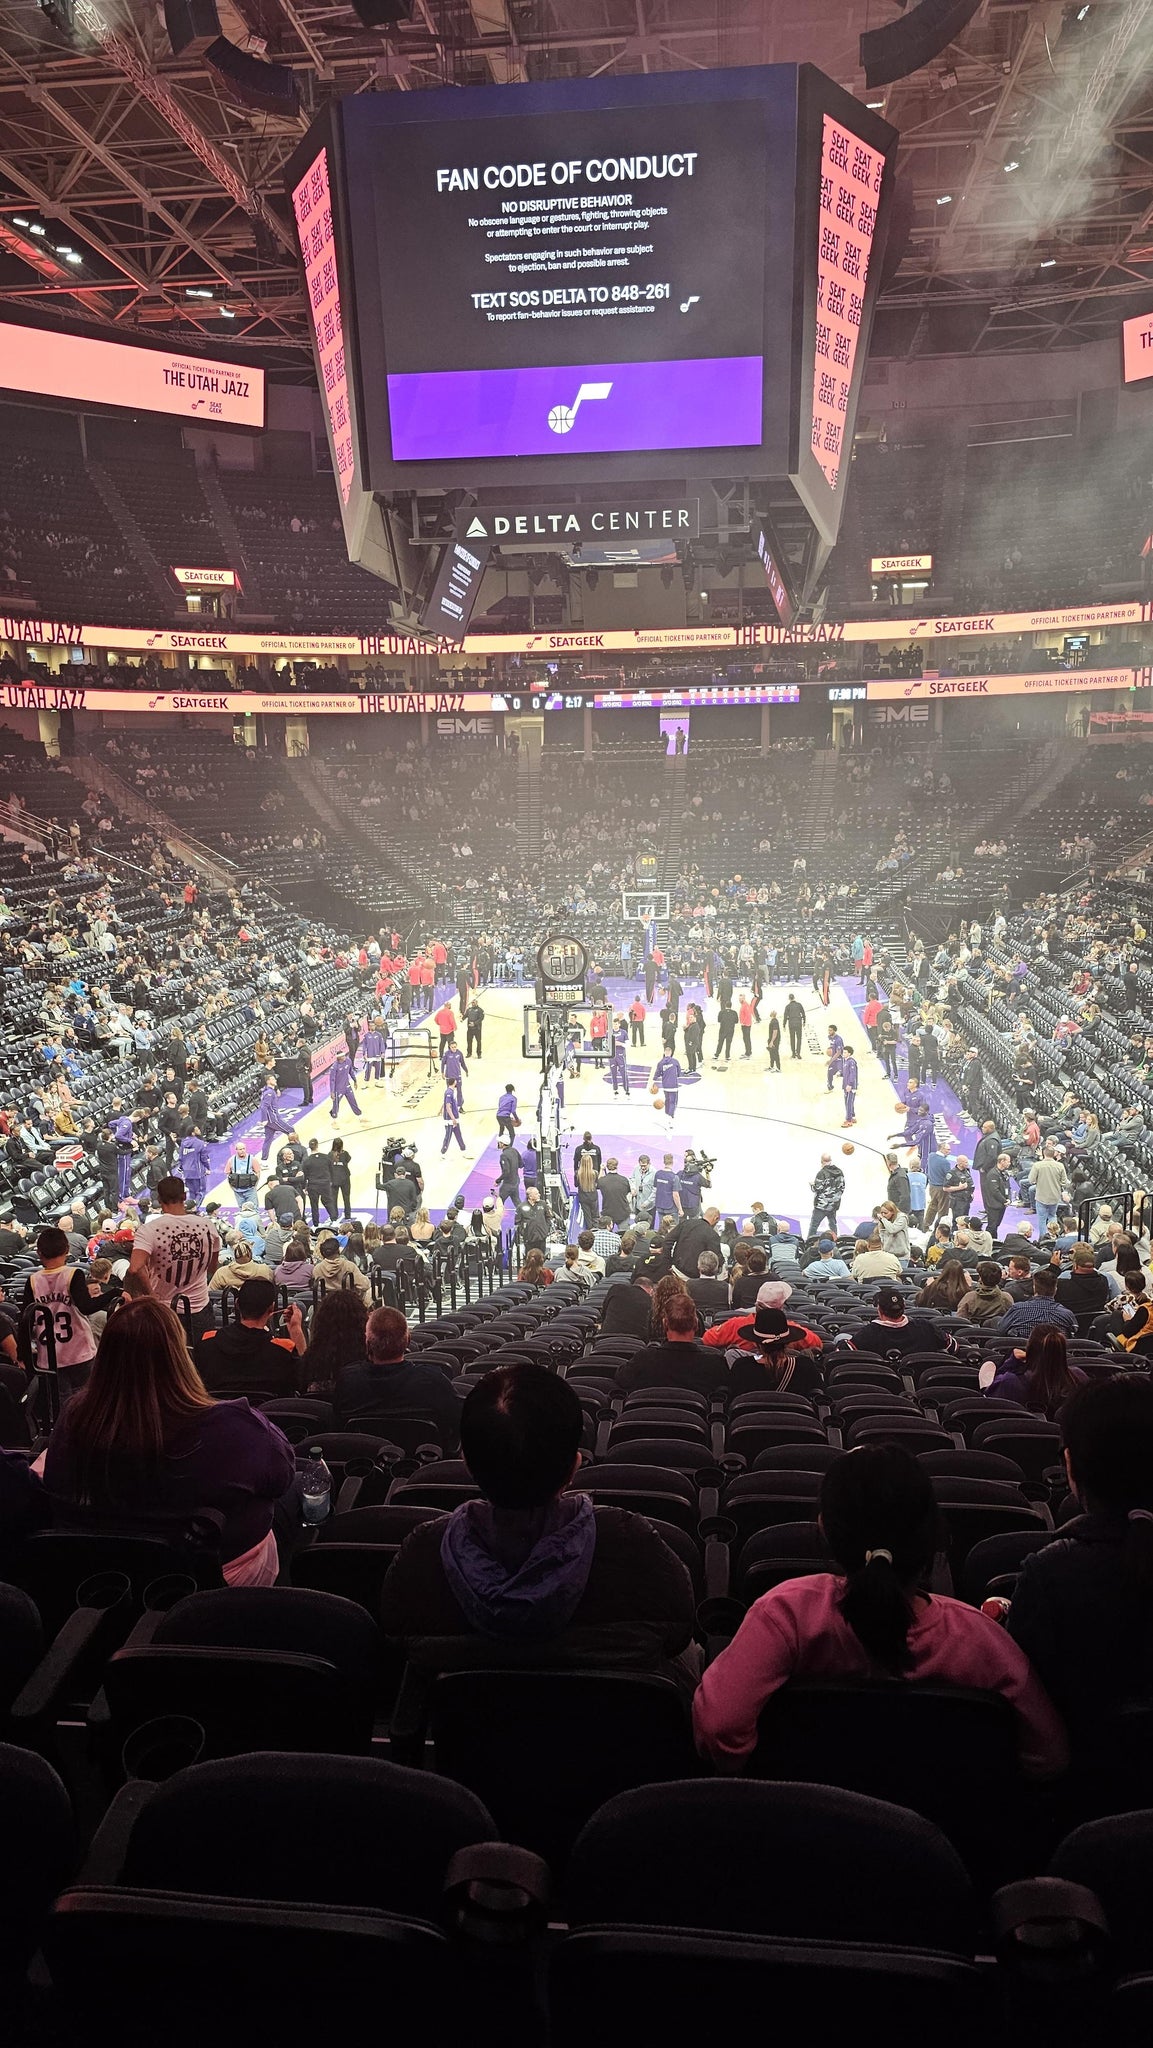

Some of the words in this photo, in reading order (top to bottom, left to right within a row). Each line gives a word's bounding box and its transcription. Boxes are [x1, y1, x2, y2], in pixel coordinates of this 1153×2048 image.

[832, 130, 849, 154] SEAT
[829, 148, 848, 173] GEEK
[855, 147, 872, 169] SEAT
[437, 167, 478, 192] FAN
[483, 162, 547, 189] CODE
[551, 161, 582, 185] OF
[586, 153, 698, 182] CONDUCT
[852, 164, 870, 188] GEEK
[501, 202, 518, 213] NO
[520, 198, 578, 212] DISRUPTIVE
[581, 194, 633, 208] BEHAVIOR
[838, 186, 856, 209] SEAT
[468, 218, 478, 227] No
[480, 217, 508, 225] obscene
[509, 216, 540, 225] language
[550, 213, 581, 224] gestures,
[581, 210, 610, 221] fighting,
[610, 209, 641, 218] throwing
[642, 207, 668, 218] objects
[836, 204, 854, 228] GEEK
[495, 227, 533, 238] attempting
[542, 226, 560, 234] enter
[561, 225, 573, 233] the
[574, 224, 593, 232] court
[602, 221, 632, 231] interrupt
[634, 220, 649, 231] play.
[823, 227, 840, 249] SEAT
[485, 253, 523, 263] Spectators
[524, 251, 556, 261] engaging
[557, 250, 563, 258] in
[564, 249, 581, 258] such
[582, 247, 613, 257] behavior
[627, 245, 653, 255] subject
[821, 244, 839, 268] GEEK
[845, 241, 861, 262] SEAT
[508, 264, 516, 272] to
[517, 263, 547, 273] ejection,
[548, 262, 561, 270] ban
[563, 260, 576, 269] and
[577, 259, 606, 270] possible
[607, 257, 630, 266] arrest.
[842, 258, 860, 280] GEEK
[471, 292, 508, 309] TEXT
[510, 290, 539, 307] SOS
[543, 288, 587, 305] DELTA
[588, 287, 608, 303] TO
[829, 281, 846, 302] SEAT
[486, 313, 495, 321] To
[496, 313, 516, 322] report
[517, 310, 560, 320] fan-behavior
[562, 309, 583, 317] issues
[591, 306, 618, 316] request
[618, 305, 655, 314] assistance
[827, 298, 845, 319] GEEK
[835, 333, 851, 352] SEAT
[833, 349, 850, 369] GEEK
[172, 362, 192, 371] OFFICIAL
[193, 366, 215, 374] TICKETING
[216, 369, 234, 378] PARTNER
[163, 369, 185, 387] THE
[188, 374, 218, 393] UTAH
[221, 379, 249, 397] JAZZ
[821, 372, 836, 392] SEAT
[819, 388, 835, 409] GEEK
[826, 422, 841, 439] SEAT
[824, 437, 840, 455] GEEK
[494, 514, 580, 535] DELTA
[591, 509, 690, 531] CENTER
[881, 558, 922, 569] SEATGEEK
[184, 571, 225, 582] SEATGEEK
[935, 618, 994, 634] SEATGEEK
[1031, 616, 1059, 625] OFFICIAL
[1061, 613, 1095, 622] TICKETING
[1097, 611, 1126, 619] PARTNER
[5, 619, 43, 642] UTAH
[47, 622, 84, 644] JAZZ
[637, 634, 662, 643] OFFICIAL
[664, 633, 694, 642] TICKETING
[696, 633, 722, 641] PARTNER
[733, 626, 760, 645] THE
[170, 635, 227, 649] SEATGEEK
[289, 641, 319, 649] TICKETING
[357, 636, 385, 654] THE
[549, 635, 604, 648] SEATGEEK
[929, 680, 988, 694] SEATGEEK
[1024, 679, 1053, 688] OFFICIAL
[1054, 677, 1088, 686] TICKETING
[1089, 676, 1118, 684] PARTNER
[8, 686, 47, 709] UTAH
[50, 689, 87, 709] JAZZ
[172, 696, 229, 710] SEATGEEK
[358, 695, 385, 712] THE
[388, 695, 426, 712] UTAH
[430, 694, 465, 712] JAZZ
[513, 698, 520, 709] 0
[532, 698, 540, 709] 0
[565, 696, 582, 708] 2:17
[853, 687, 866, 700] PM
[870, 705, 929, 722] SME
[437, 718, 494, 734] SME
